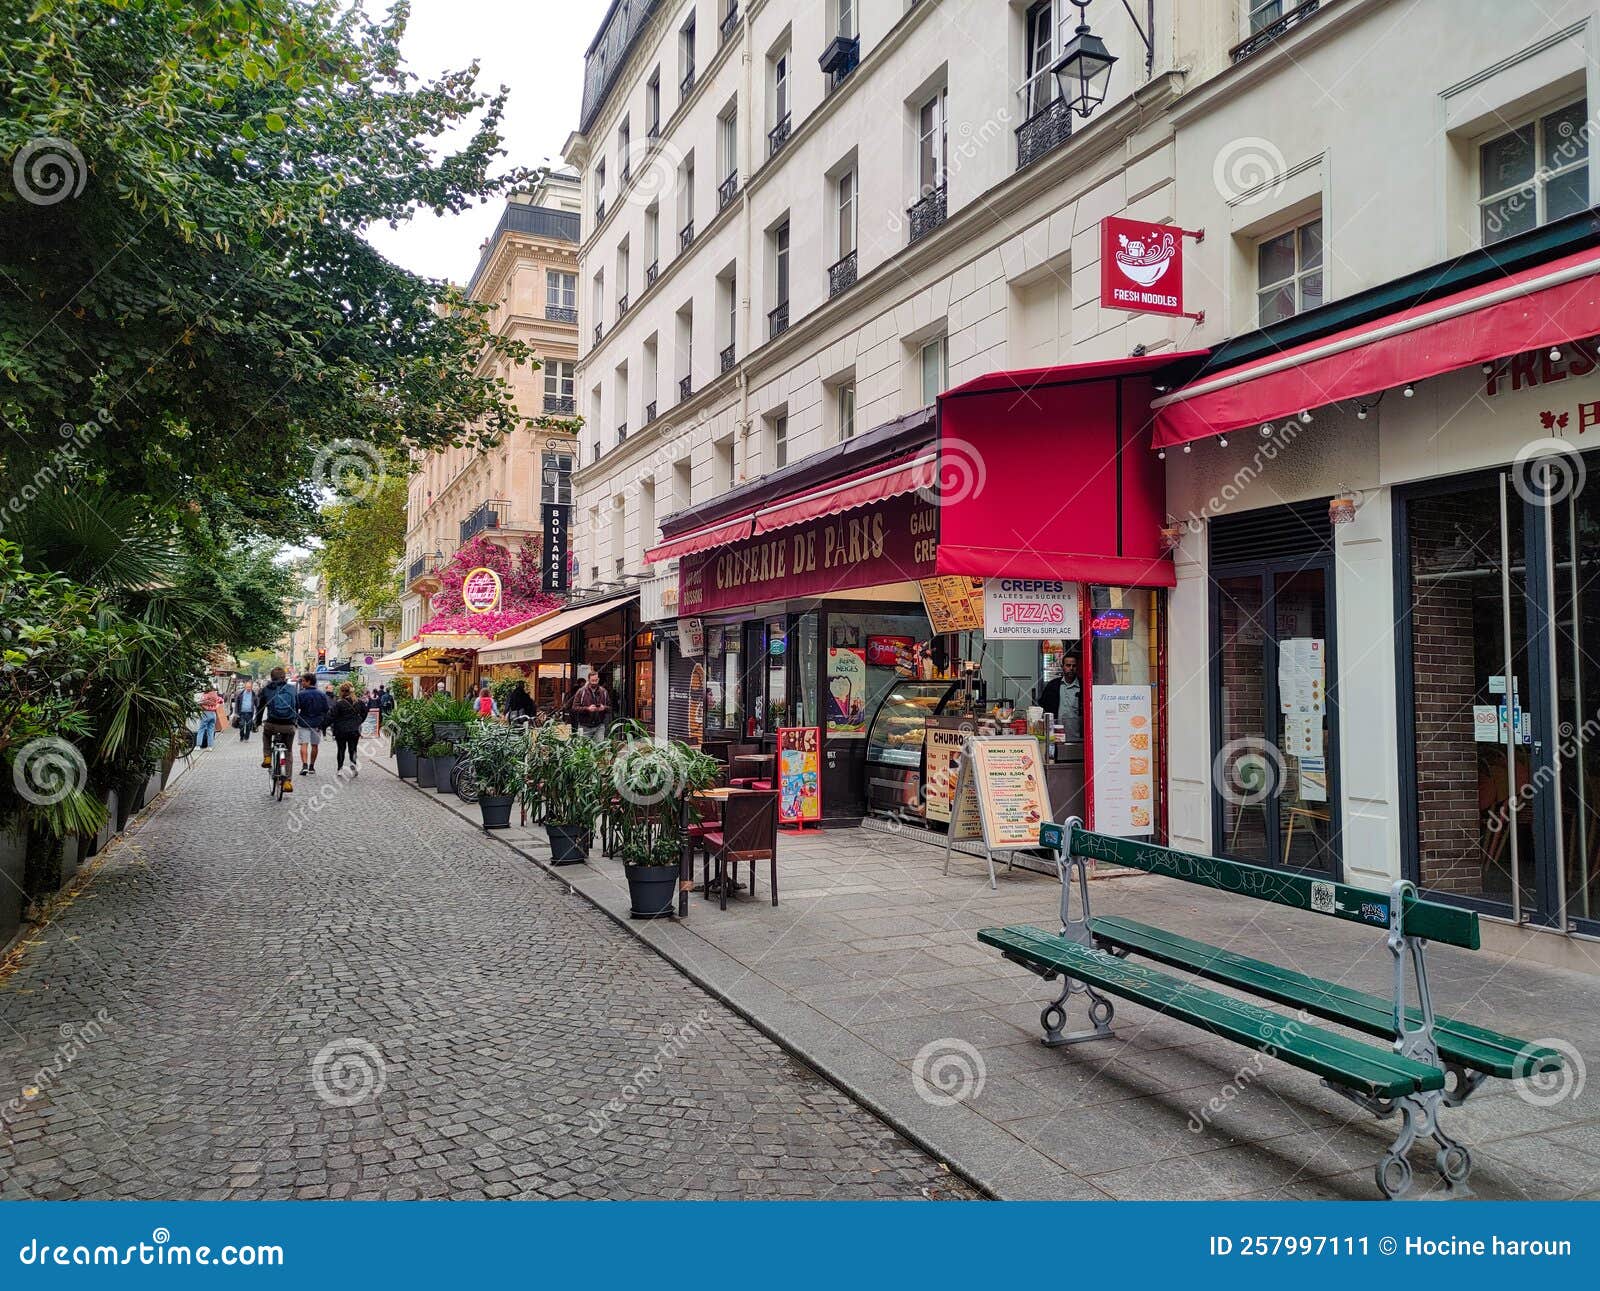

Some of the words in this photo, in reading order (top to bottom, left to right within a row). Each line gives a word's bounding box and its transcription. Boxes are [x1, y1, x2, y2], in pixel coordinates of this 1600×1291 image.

[1114, 289, 1140, 302] FRESH
[1141, 293, 1177, 307] NOODLES
[551, 509, 560, 588] BOULANGER
[716, 539, 786, 590] CREPERIE
[792, 530, 816, 575] DE
[824, 511, 884, 569] PARIS
[1001, 579, 1064, 592] CREPES
[1002, 602, 1064, 624] PIZZAS
[999, 626, 1031, 634] EMPORTER
[1040, 626, 1072, 634] SURPLACE
[1091, 618, 1131, 631] CREPE
